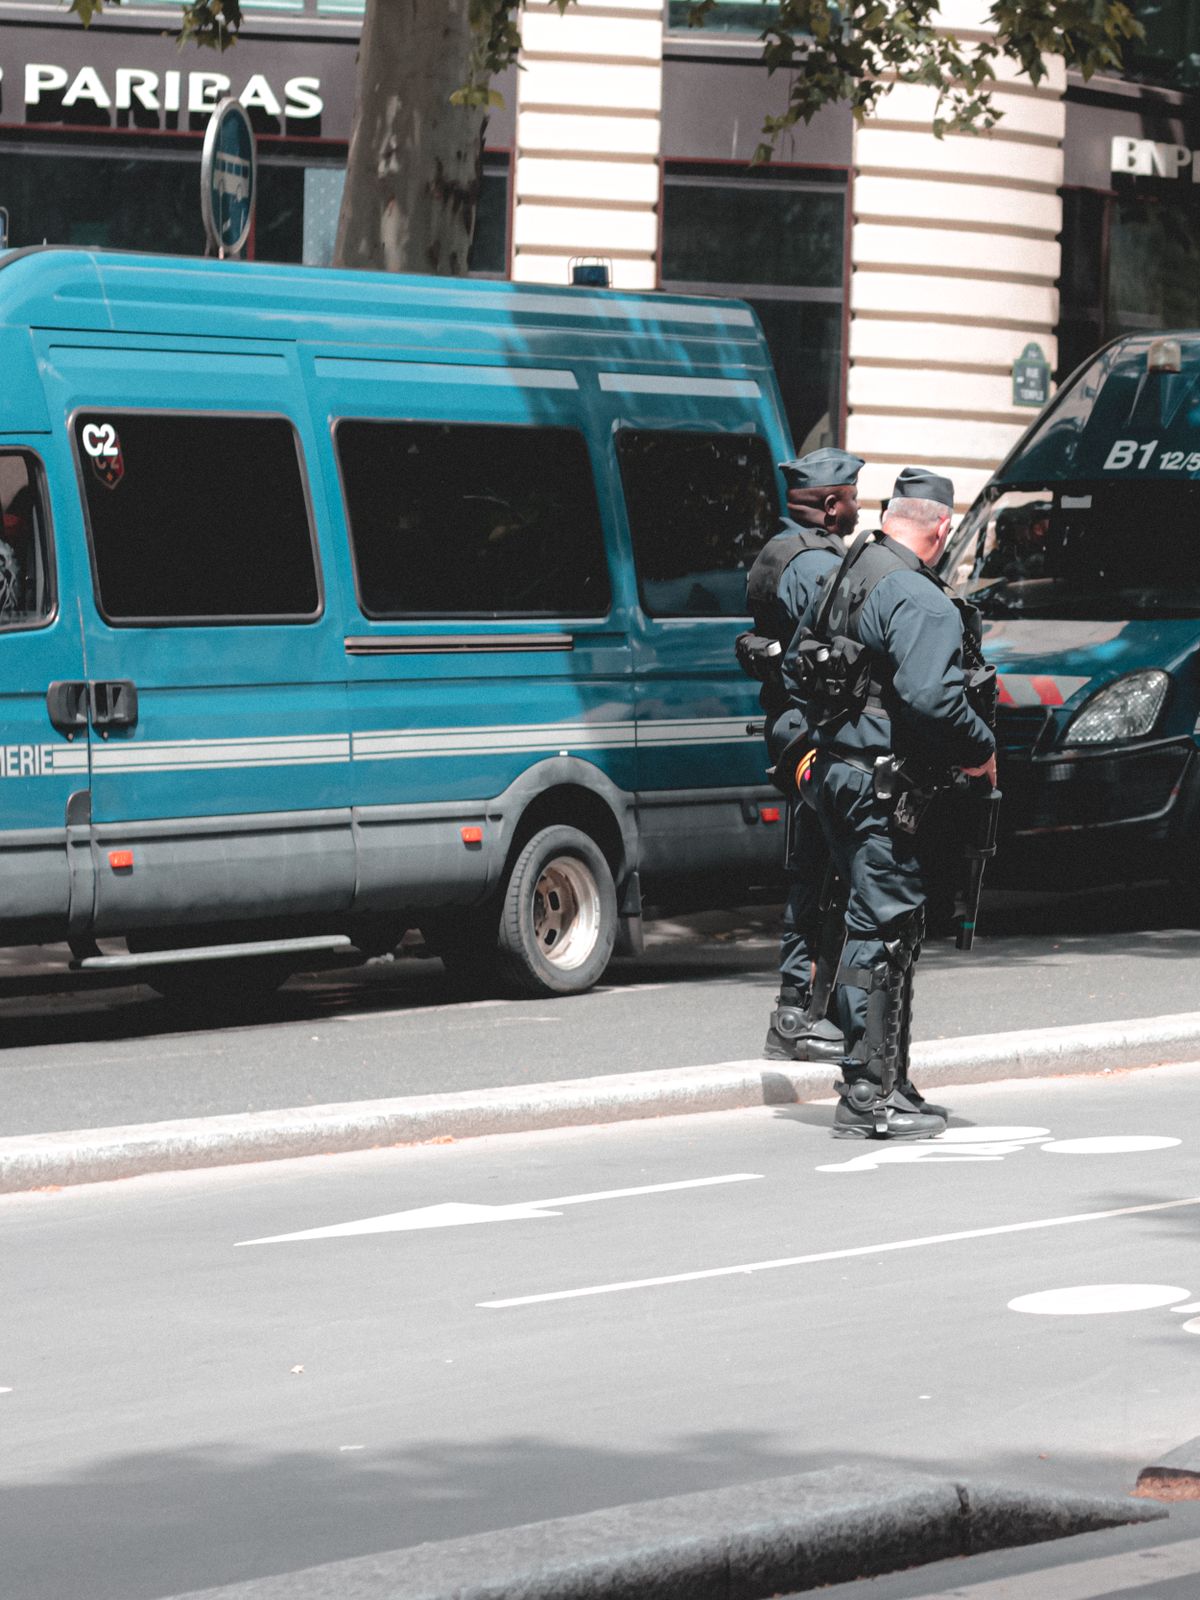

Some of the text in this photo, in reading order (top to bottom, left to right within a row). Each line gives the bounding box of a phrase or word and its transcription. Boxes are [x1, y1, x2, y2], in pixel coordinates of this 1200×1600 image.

[24, 63, 324, 119] PARIBAS
[1111, 136, 1192, 179] BNP
[82, 423, 119, 457] C2
[1103, 440, 1159, 470] B1
